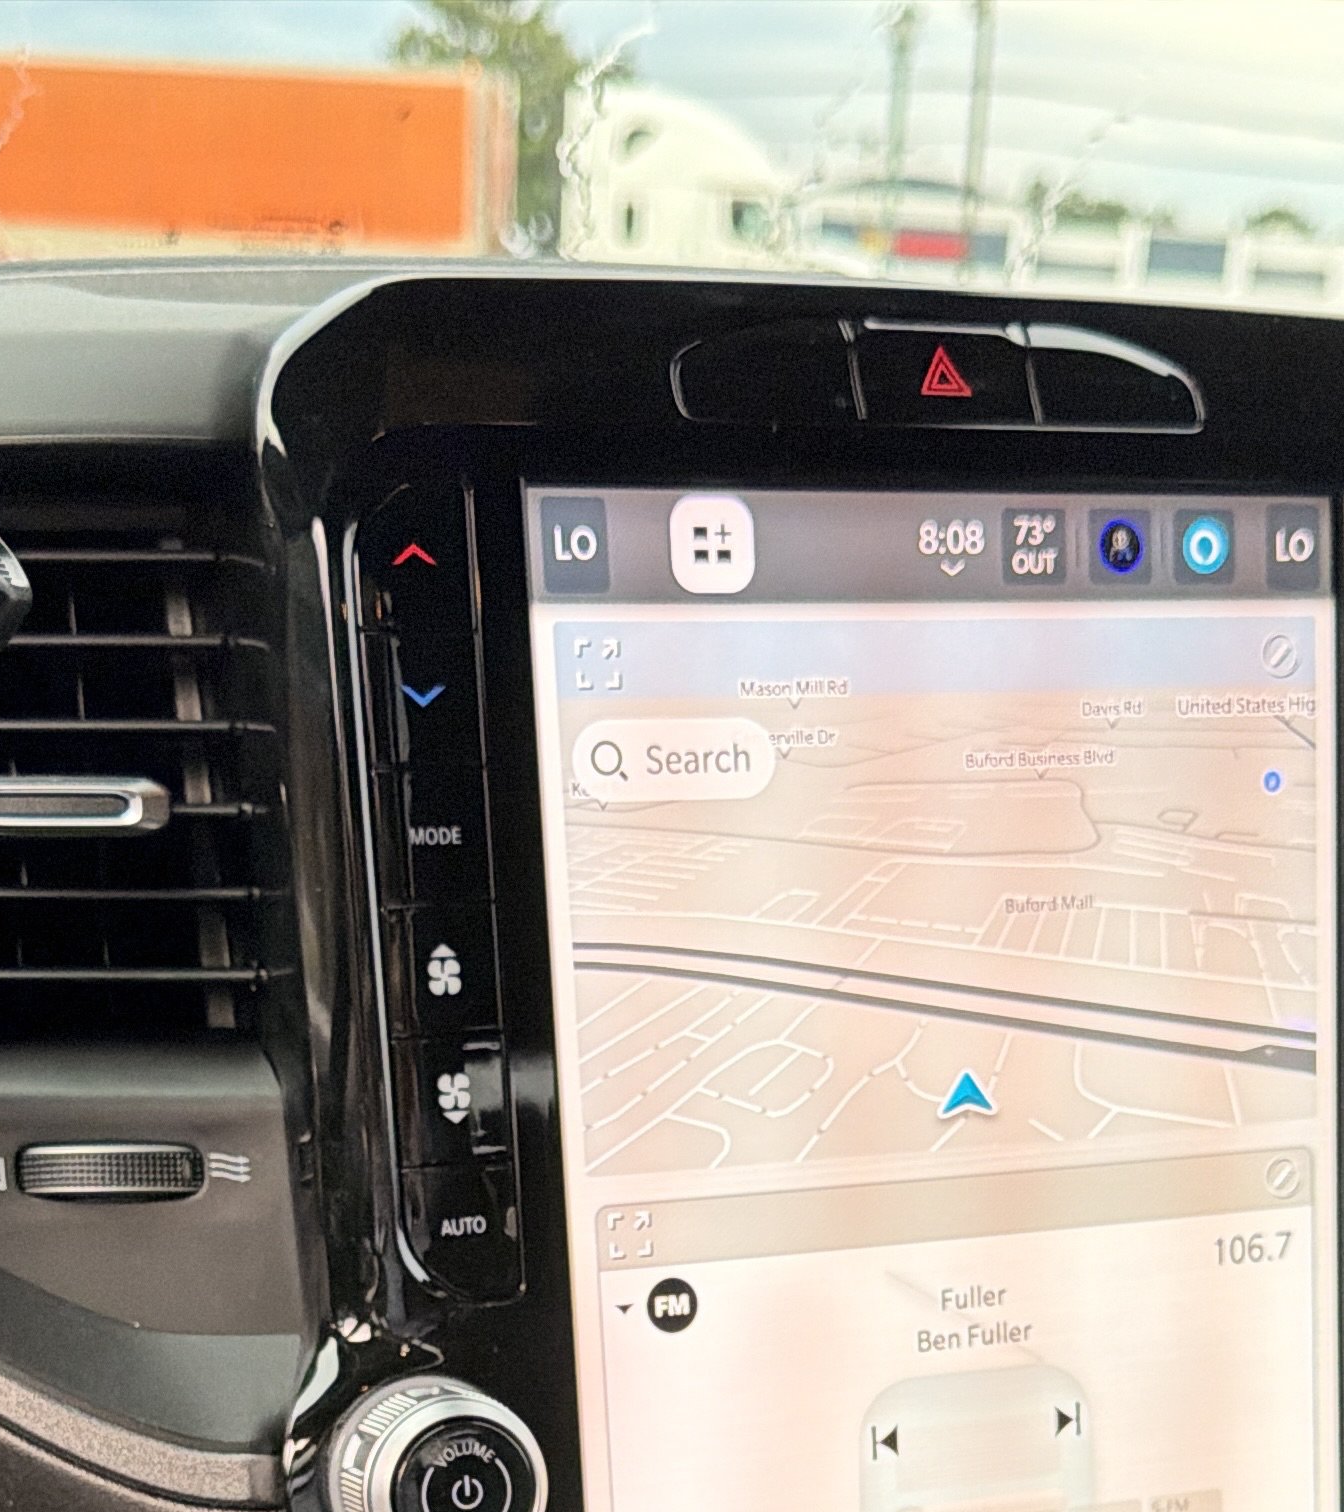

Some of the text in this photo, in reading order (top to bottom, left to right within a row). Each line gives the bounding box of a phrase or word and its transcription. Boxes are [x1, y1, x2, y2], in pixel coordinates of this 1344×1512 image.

[554, 524, 597, 561] LO
[918, 519, 984, 555] 8:08
[1275, 528, 1315, 563] LO
[1011, 550, 1056, 575] OUT
[740, 681, 847, 697] Mason Mill Rd
[1124, 701, 1142, 715] Rd
[1177, 698, 1232, 716] United
[1236, 698, 1284, 714] States
[818, 730, 836, 745] Dr
[646, 743, 751, 776] Search
[966, 750, 1114, 769] Buford Business Blvd
[409, 826, 462, 847] MODE
[1005, 894, 1093, 914] Buford Mall
[441, 1216, 487, 1238] AUTO
[1213, 1231, 1292, 1266] 106.7
[655, 1293, 691, 1317] FM
[941, 1286, 1007, 1312] Fuller
[917, 1320, 1033, 1353] Ben Fuller
[433, 1439, 496, 1469] VOLUME
